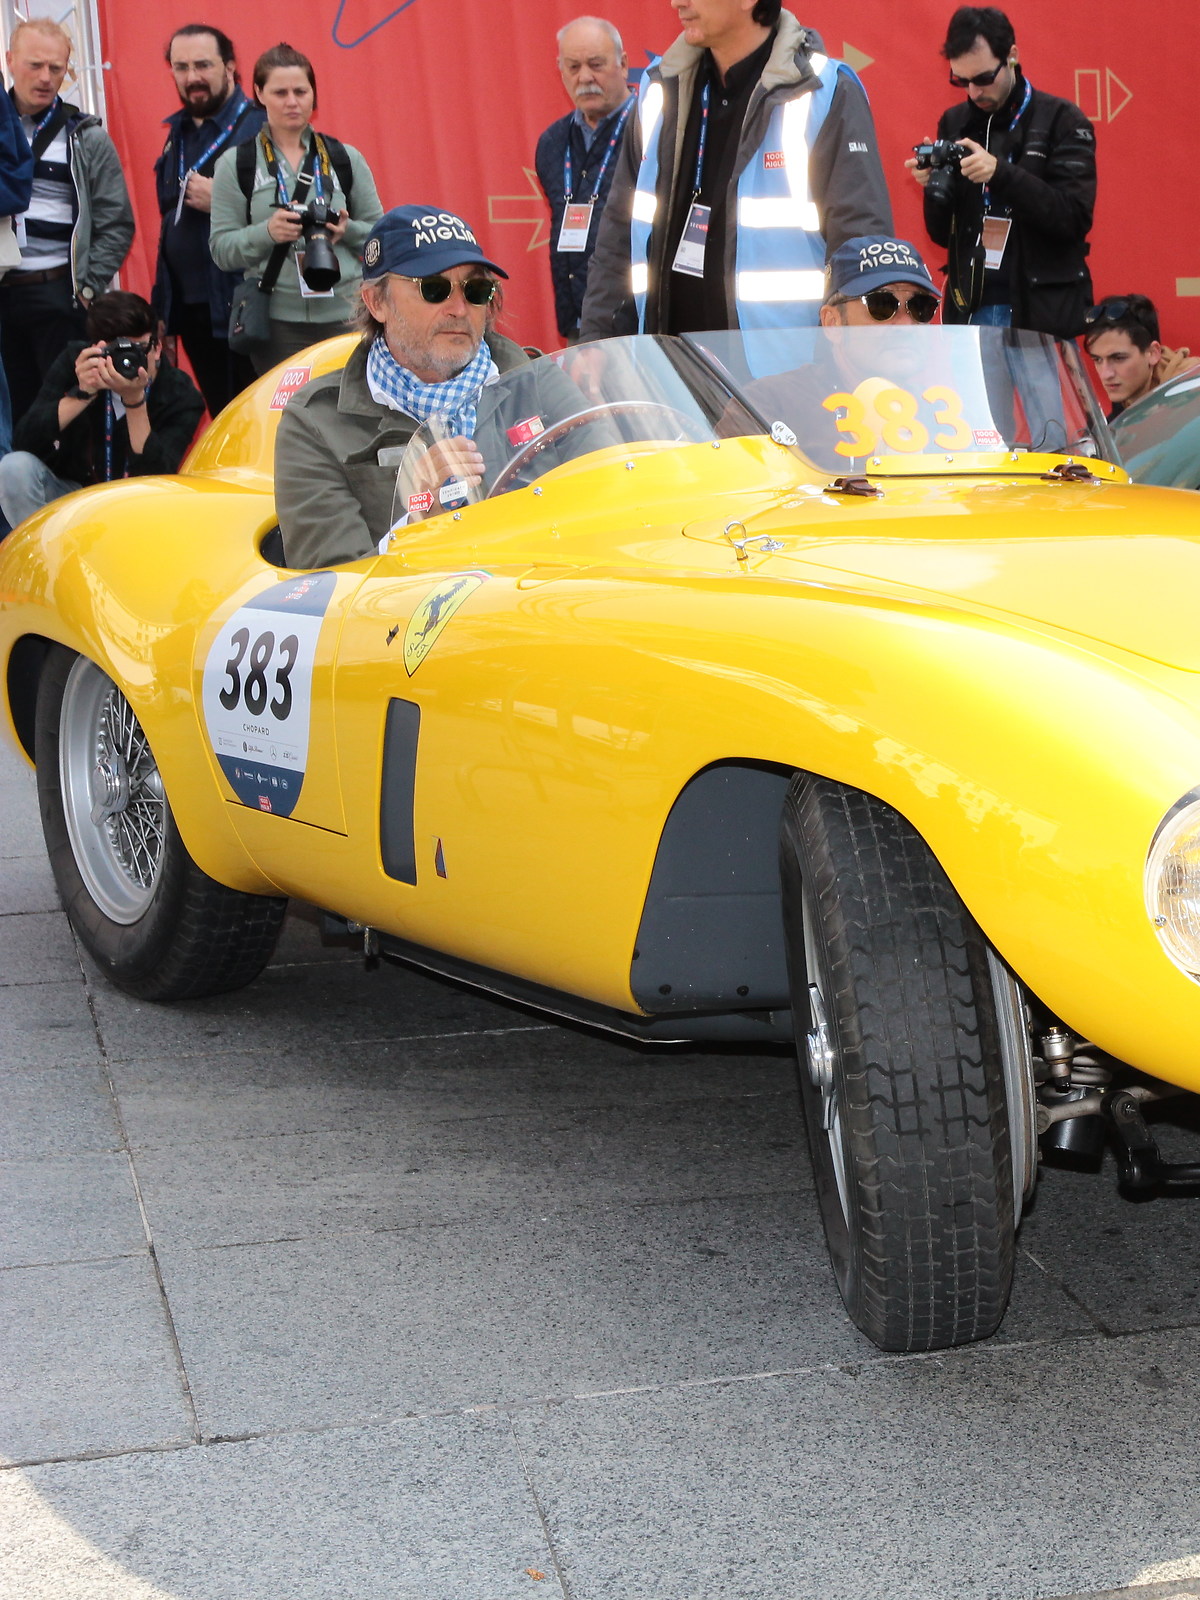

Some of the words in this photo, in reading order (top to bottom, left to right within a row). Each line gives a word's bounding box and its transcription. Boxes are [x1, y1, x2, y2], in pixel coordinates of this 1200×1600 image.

[766, 152, 785, 161] 1000
[411, 213, 465, 231] 1000
[415, 226, 477, 248] MIGLIA
[860, 242, 910, 258] 1000
[859, 253, 919, 272] MIGLIA
[282, 371, 304, 386] 1000
[821, 385, 973, 458] 383
[410, 501, 428, 511] MIGLIA
[411, 494, 428, 503] 1000
[218, 627, 299, 721] 383
[243, 723, 270, 736] CHOPARD
